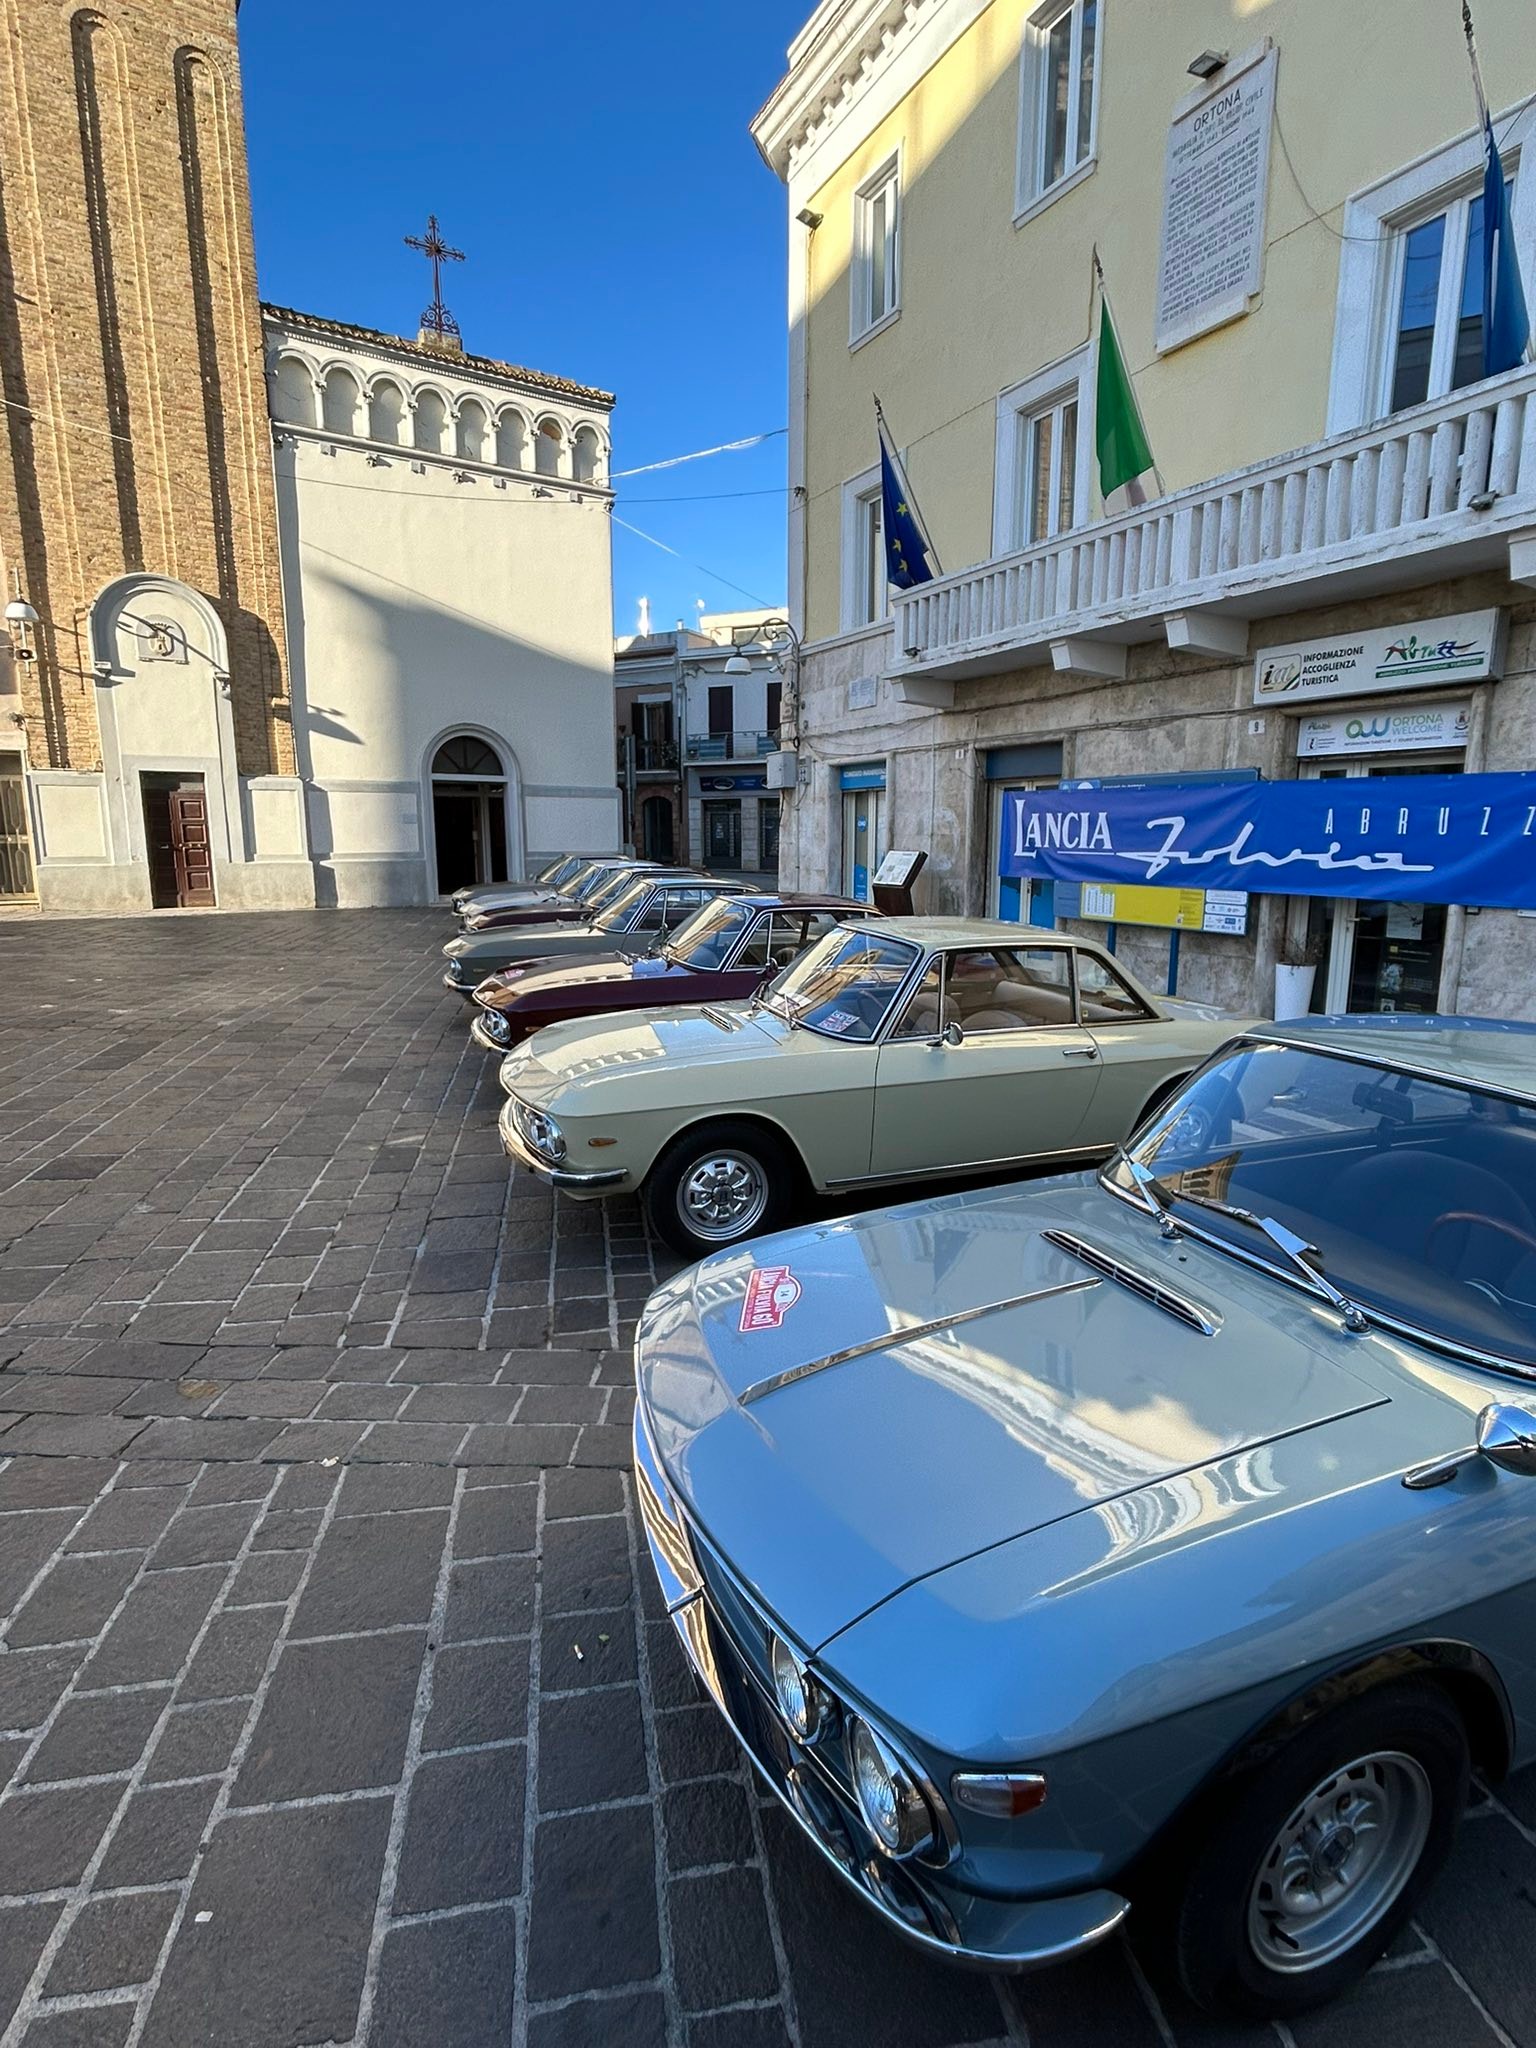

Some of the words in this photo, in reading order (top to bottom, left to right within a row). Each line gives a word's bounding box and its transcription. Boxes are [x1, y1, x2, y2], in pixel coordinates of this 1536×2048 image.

[1193, 86, 1241, 133] ORTONA
[1303, 646, 1364, 662] INFORMAZIONE
[1302, 660, 1356, 674] ACCOGLIENZA
[1302, 674, 1339, 686] TURISTICA
[1254, 721, 1259, 732] 9
[1392, 713, 1443, 727] ORTONA
[1392, 724, 1443, 736] WELCOME
[1014, 799, 1112, 858] LANCIA
[758, 1270, 782, 1290] LANCIA
[754, 1290, 772, 1314] FULVIA
